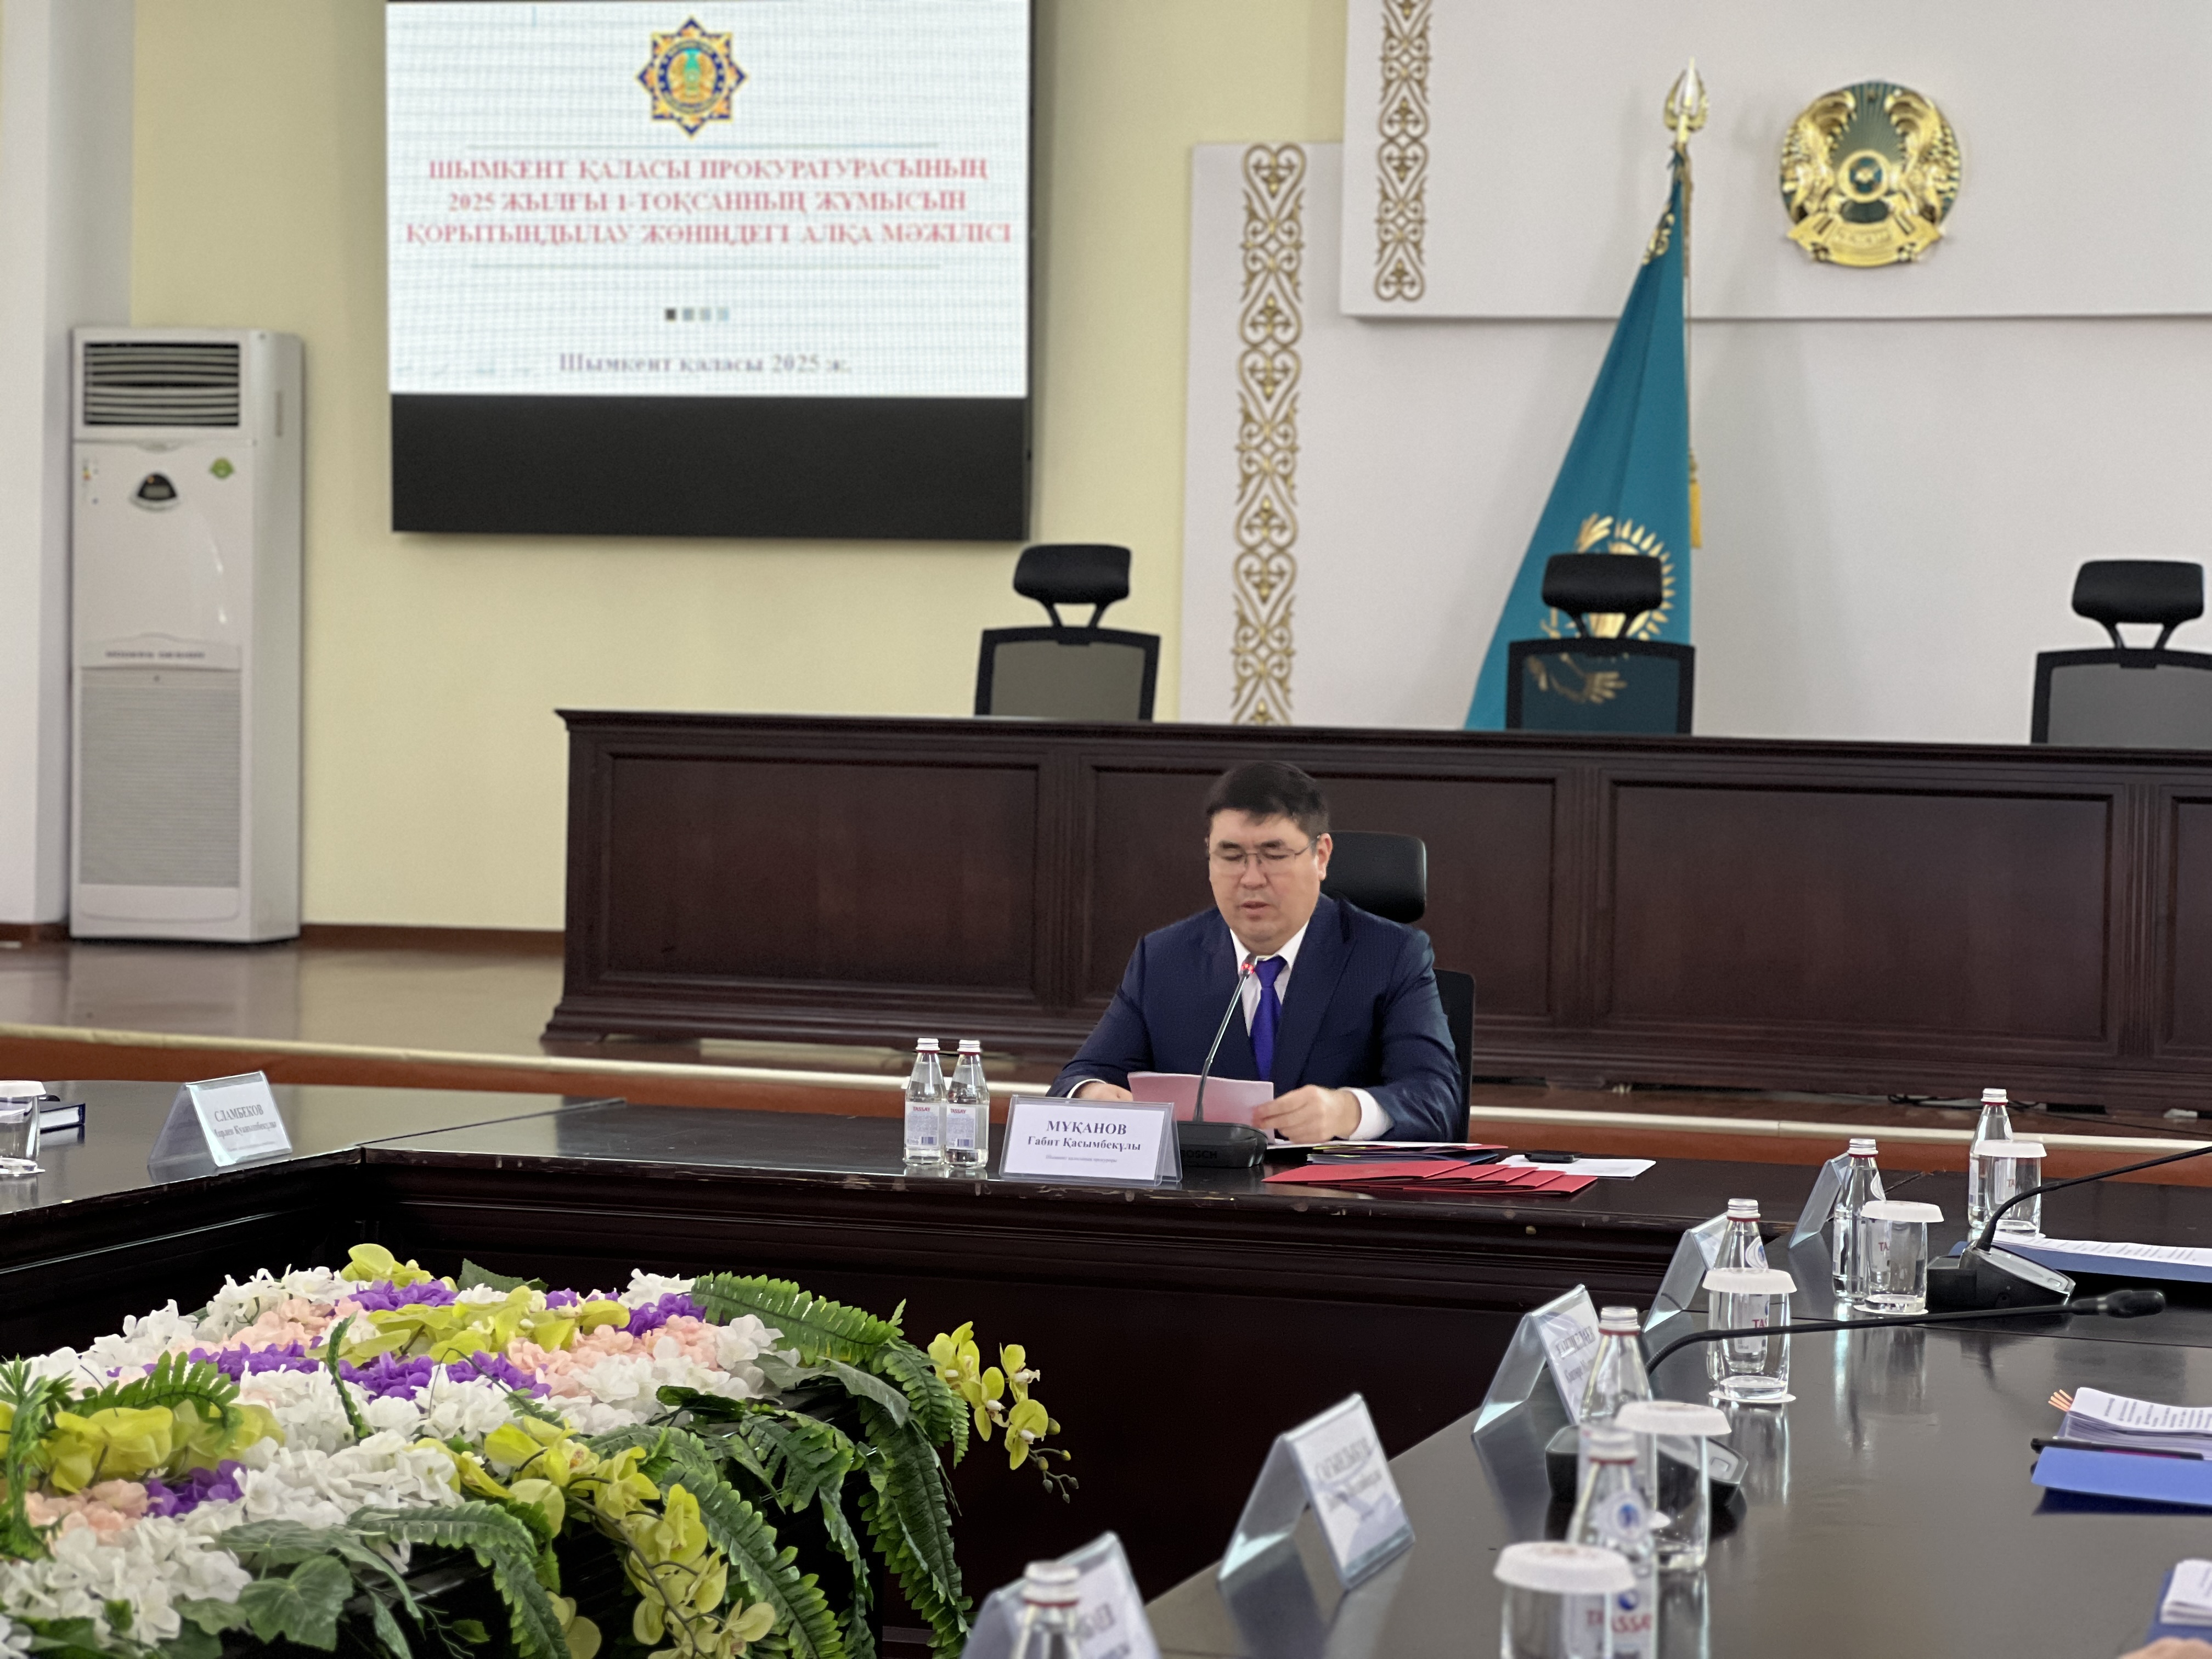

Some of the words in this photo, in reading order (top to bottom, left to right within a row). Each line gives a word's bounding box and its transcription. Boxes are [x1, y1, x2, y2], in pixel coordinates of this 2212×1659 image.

[429, 160, 567, 180] ШЫМКЕНТ
[579, 160, 690, 182] ҚАЛАСЫ
[700, 158, 988, 180] ПРОКУРАТУРАСЫНЫҢ
[448, 192, 495, 212] 2025
[407, 223, 633, 246] ҚОРЫТЫНДЫЛАУ
[803, 224, 873, 246] АЛҚА
[559, 353, 673, 373] Шымкент
[772, 354, 821, 374] 2025
[215, 1104, 264, 1122] СЛАМБЕКОВ
[1046, 1120, 1127, 1136] МҰҚАНОВ
